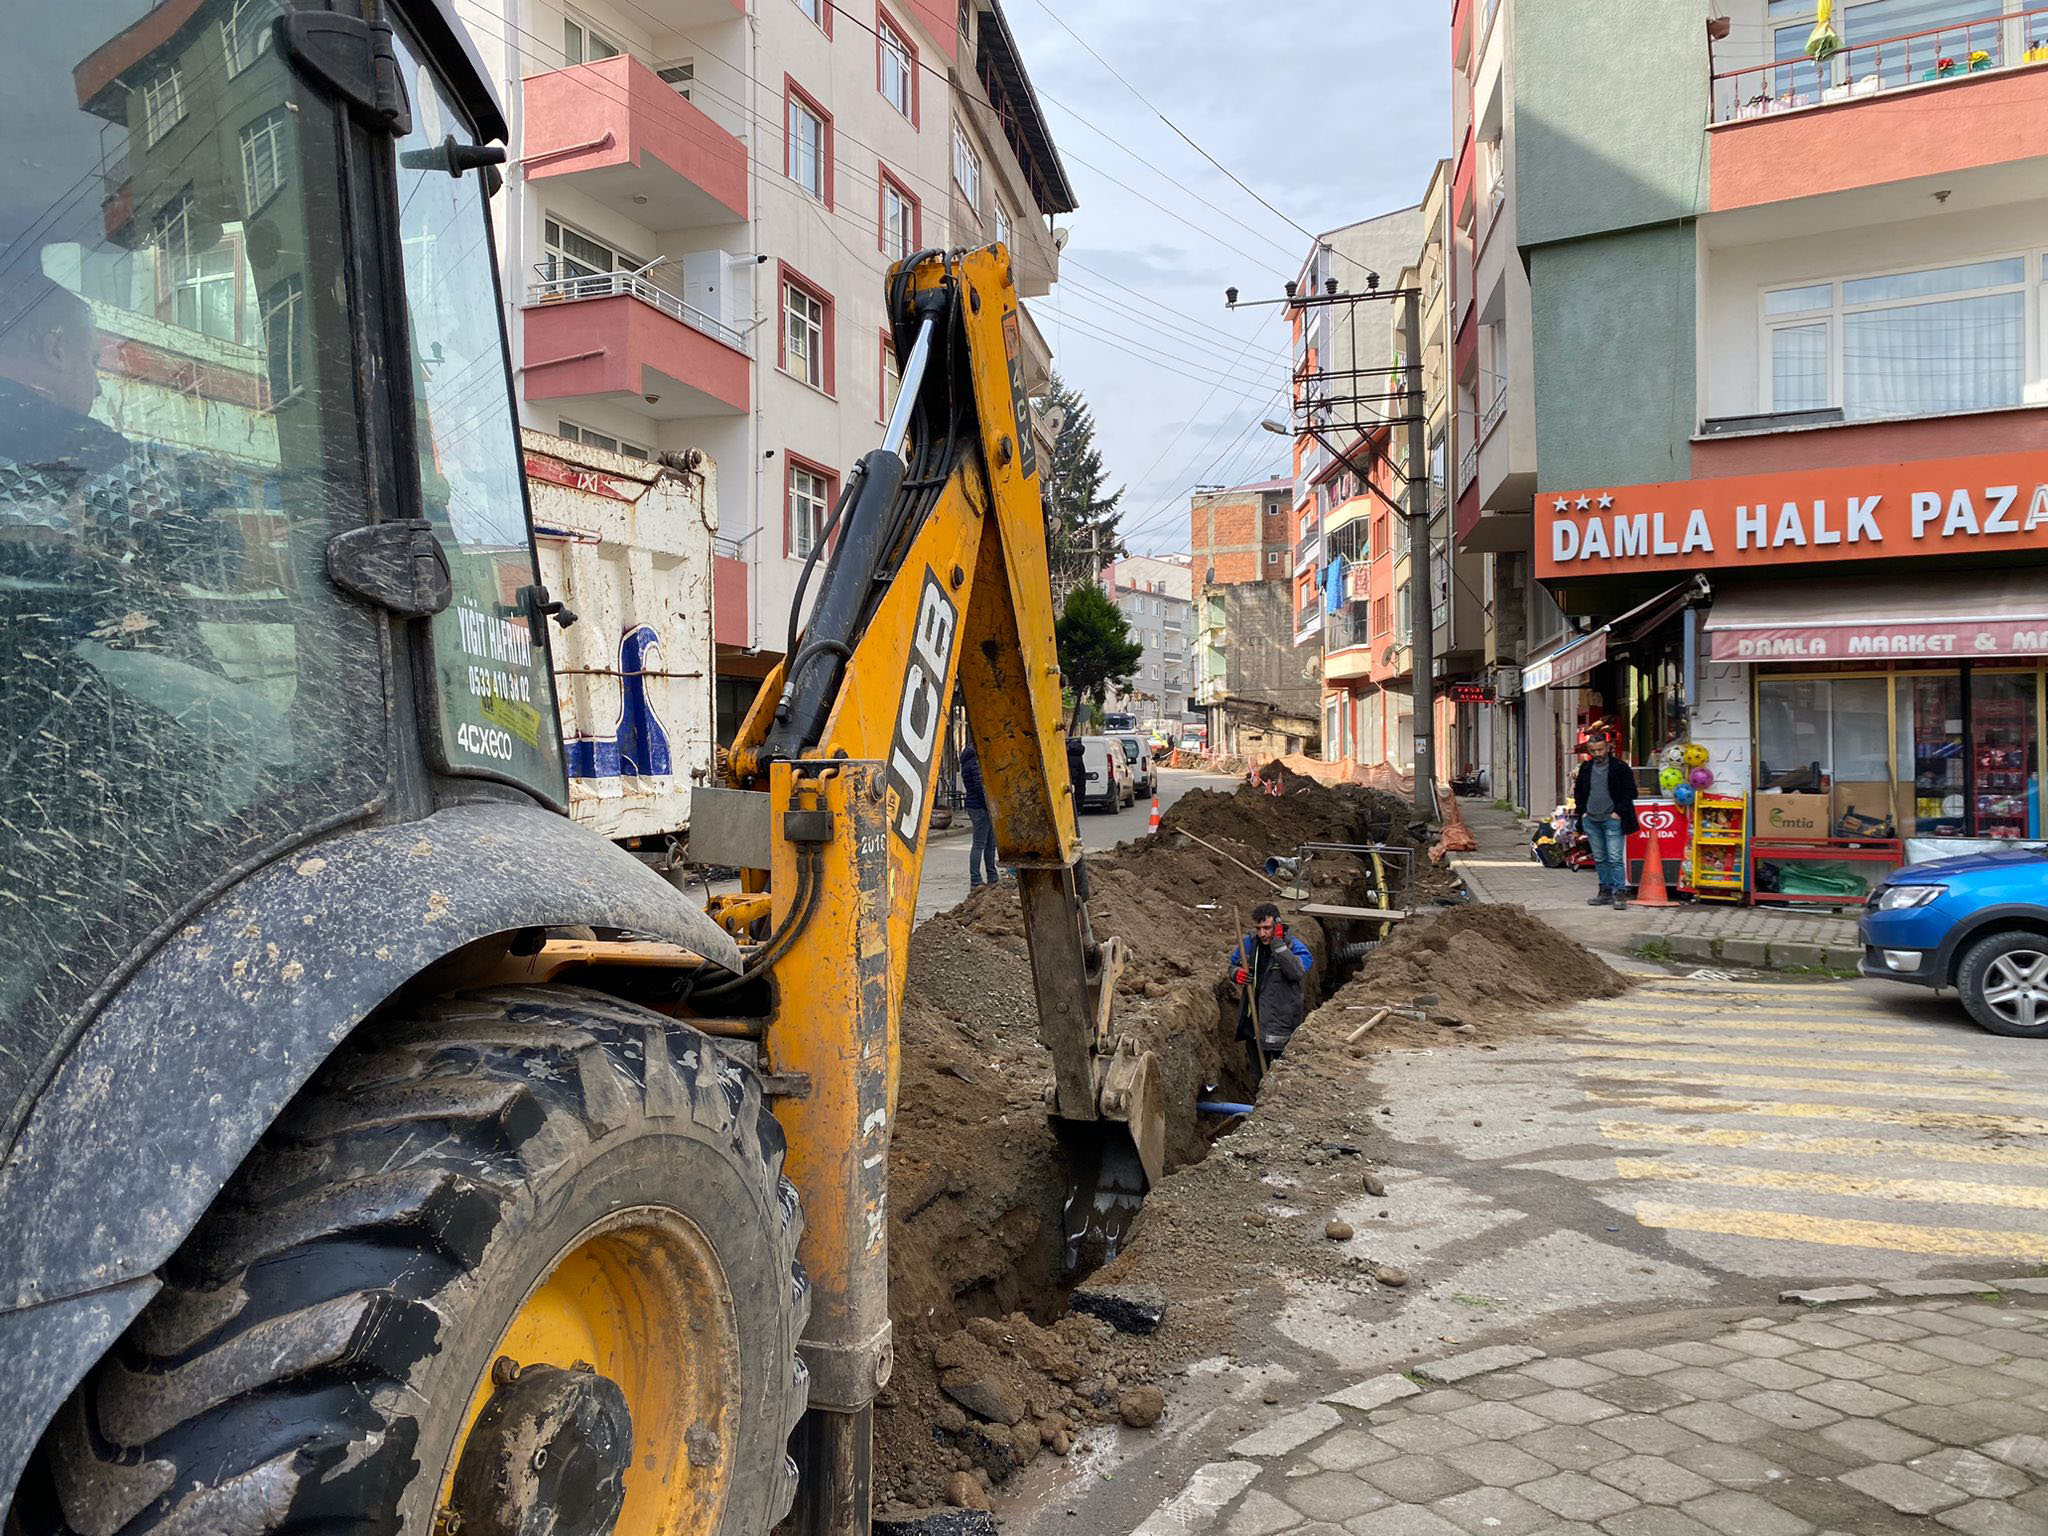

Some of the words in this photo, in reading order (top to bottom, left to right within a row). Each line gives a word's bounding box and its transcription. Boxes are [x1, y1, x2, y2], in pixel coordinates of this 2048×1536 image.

[1552, 509, 1714, 562] DAMLA
[1736, 495, 1883, 550] HALK
[1911, 484, 2048, 538] PAZA
[457, 595, 487, 657] YİĞİT
[488, 611, 532, 667] HAFRİYAT
[1738, 638, 1826, 656] DAMLA
[1848, 634, 1957, 653] MARKET
[1974, 632, 1998, 650] &
[469, 665, 491, 698] 0533
[493, 670, 508, 700] 410
[520, 675, 531, 702] 02
[892, 582, 953, 839] JCB
